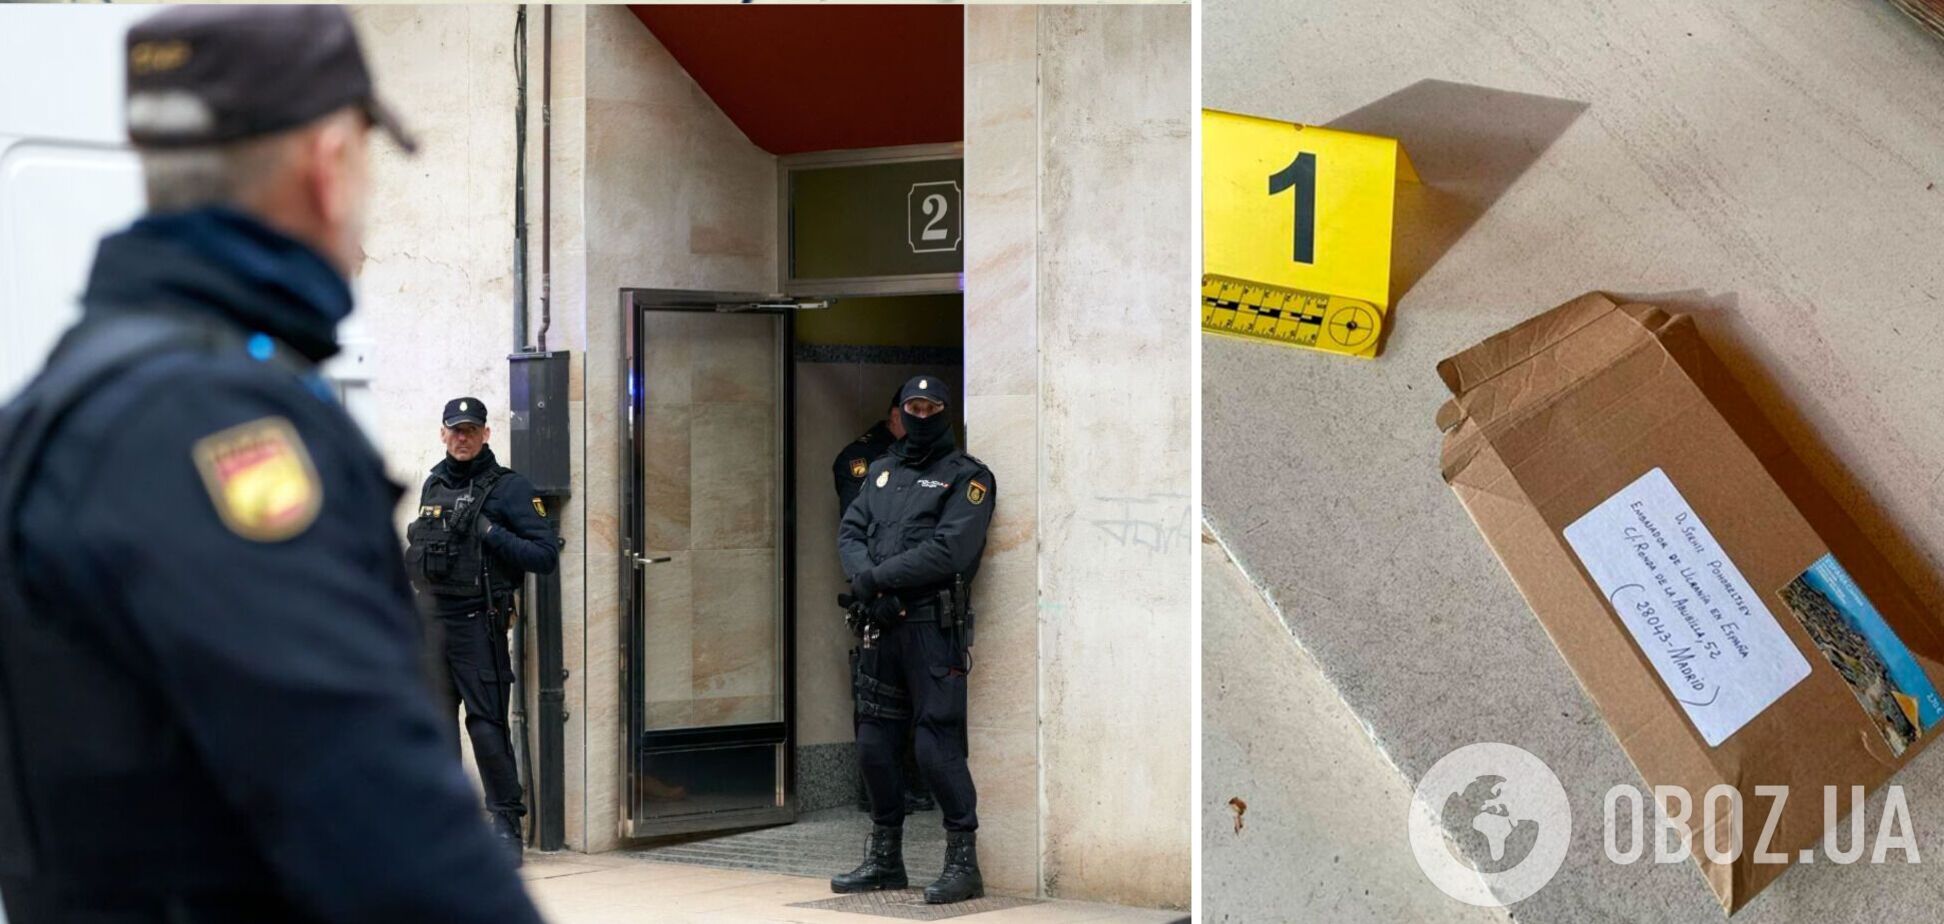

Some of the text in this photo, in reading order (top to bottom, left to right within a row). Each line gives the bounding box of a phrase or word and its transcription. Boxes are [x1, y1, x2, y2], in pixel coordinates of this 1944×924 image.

[921, 193, 948, 240] 2
[1269, 151, 1316, 265] 1
[1675, 512, 1687, 525] D.
[1655, 574, 1667, 586] DE
[1664, 587, 1676, 598] LA
[1704, 642, 1721, 659] 52
[1668, 554, 1680, 565] DE
[1710, 608, 1722, 620] EN
